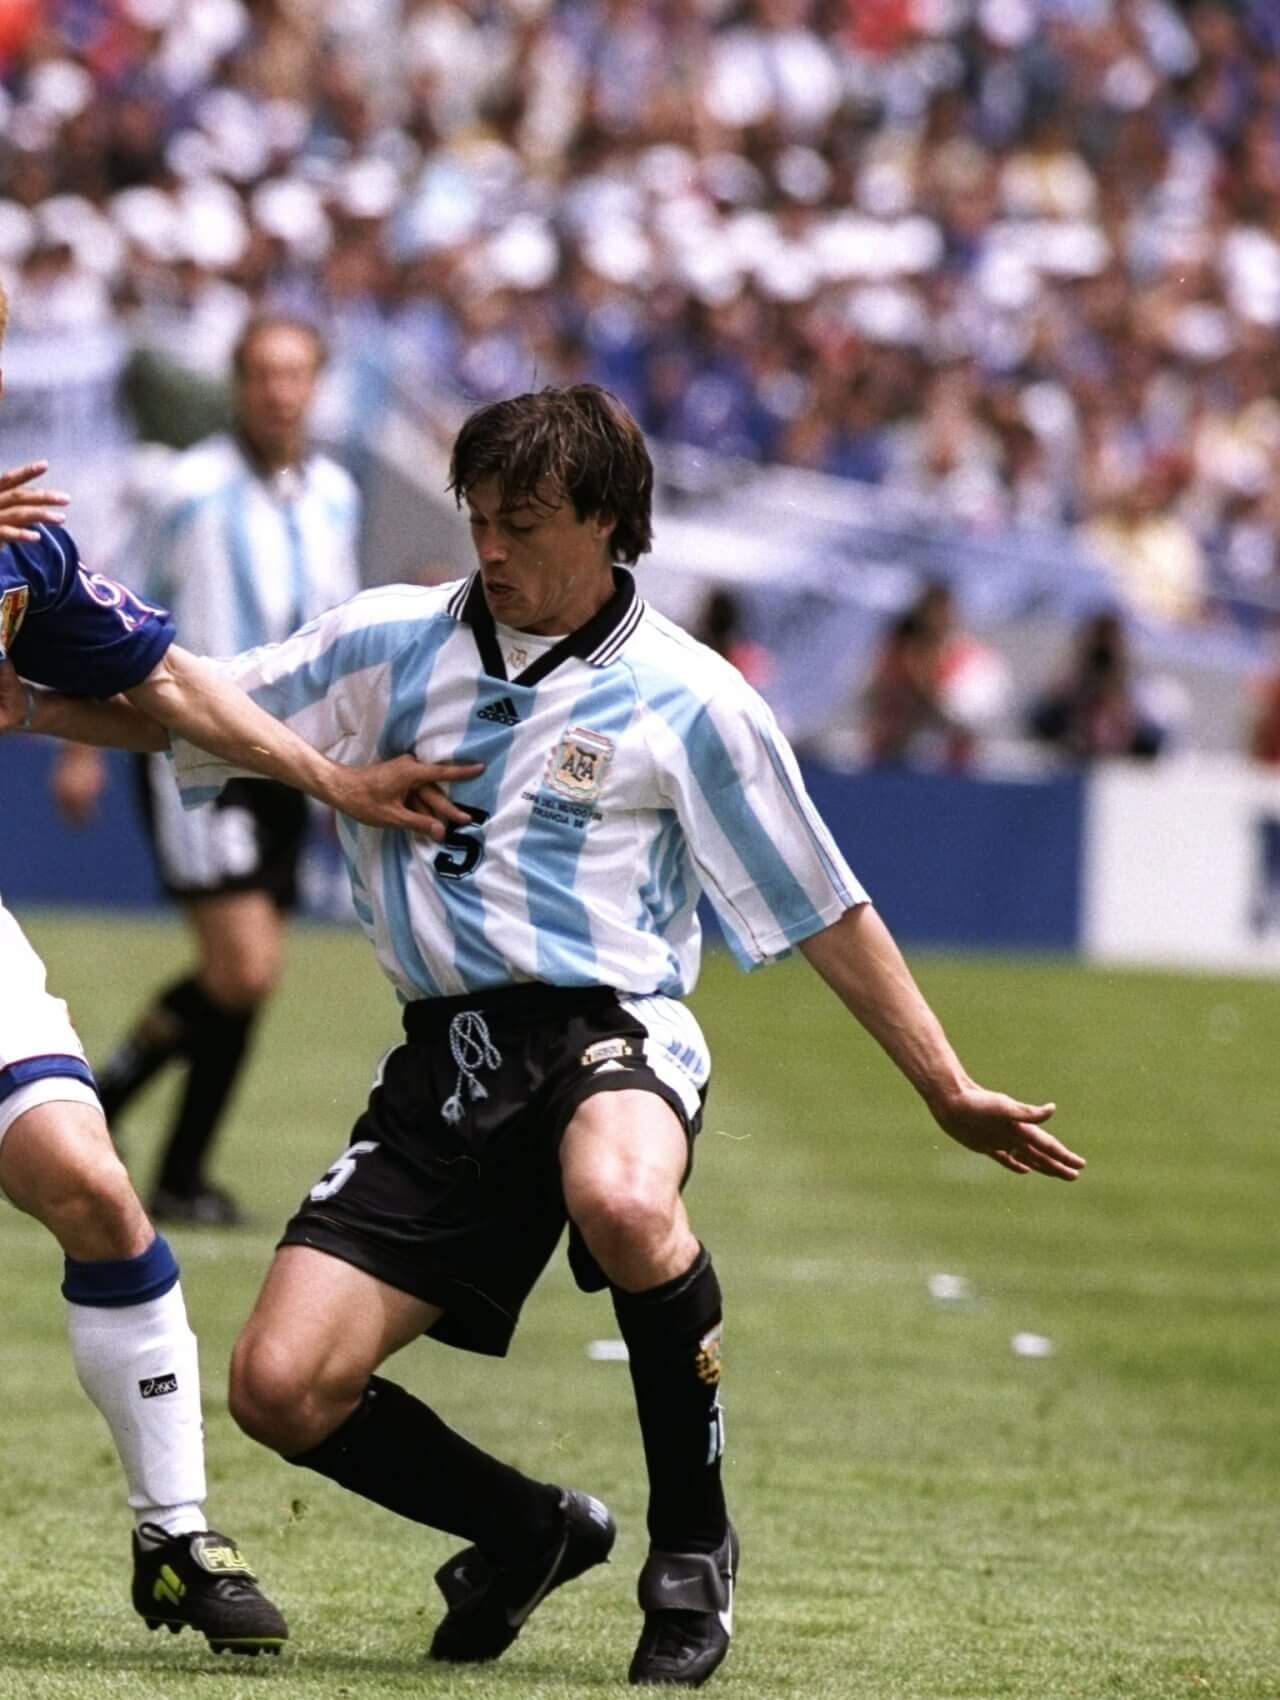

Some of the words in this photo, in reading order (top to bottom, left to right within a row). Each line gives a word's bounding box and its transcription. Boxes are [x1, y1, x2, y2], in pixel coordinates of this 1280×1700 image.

[433, 802, 490, 880] 5
[310, 1140, 380, 1201] 5
[203, 1547, 248, 1567] FIL
